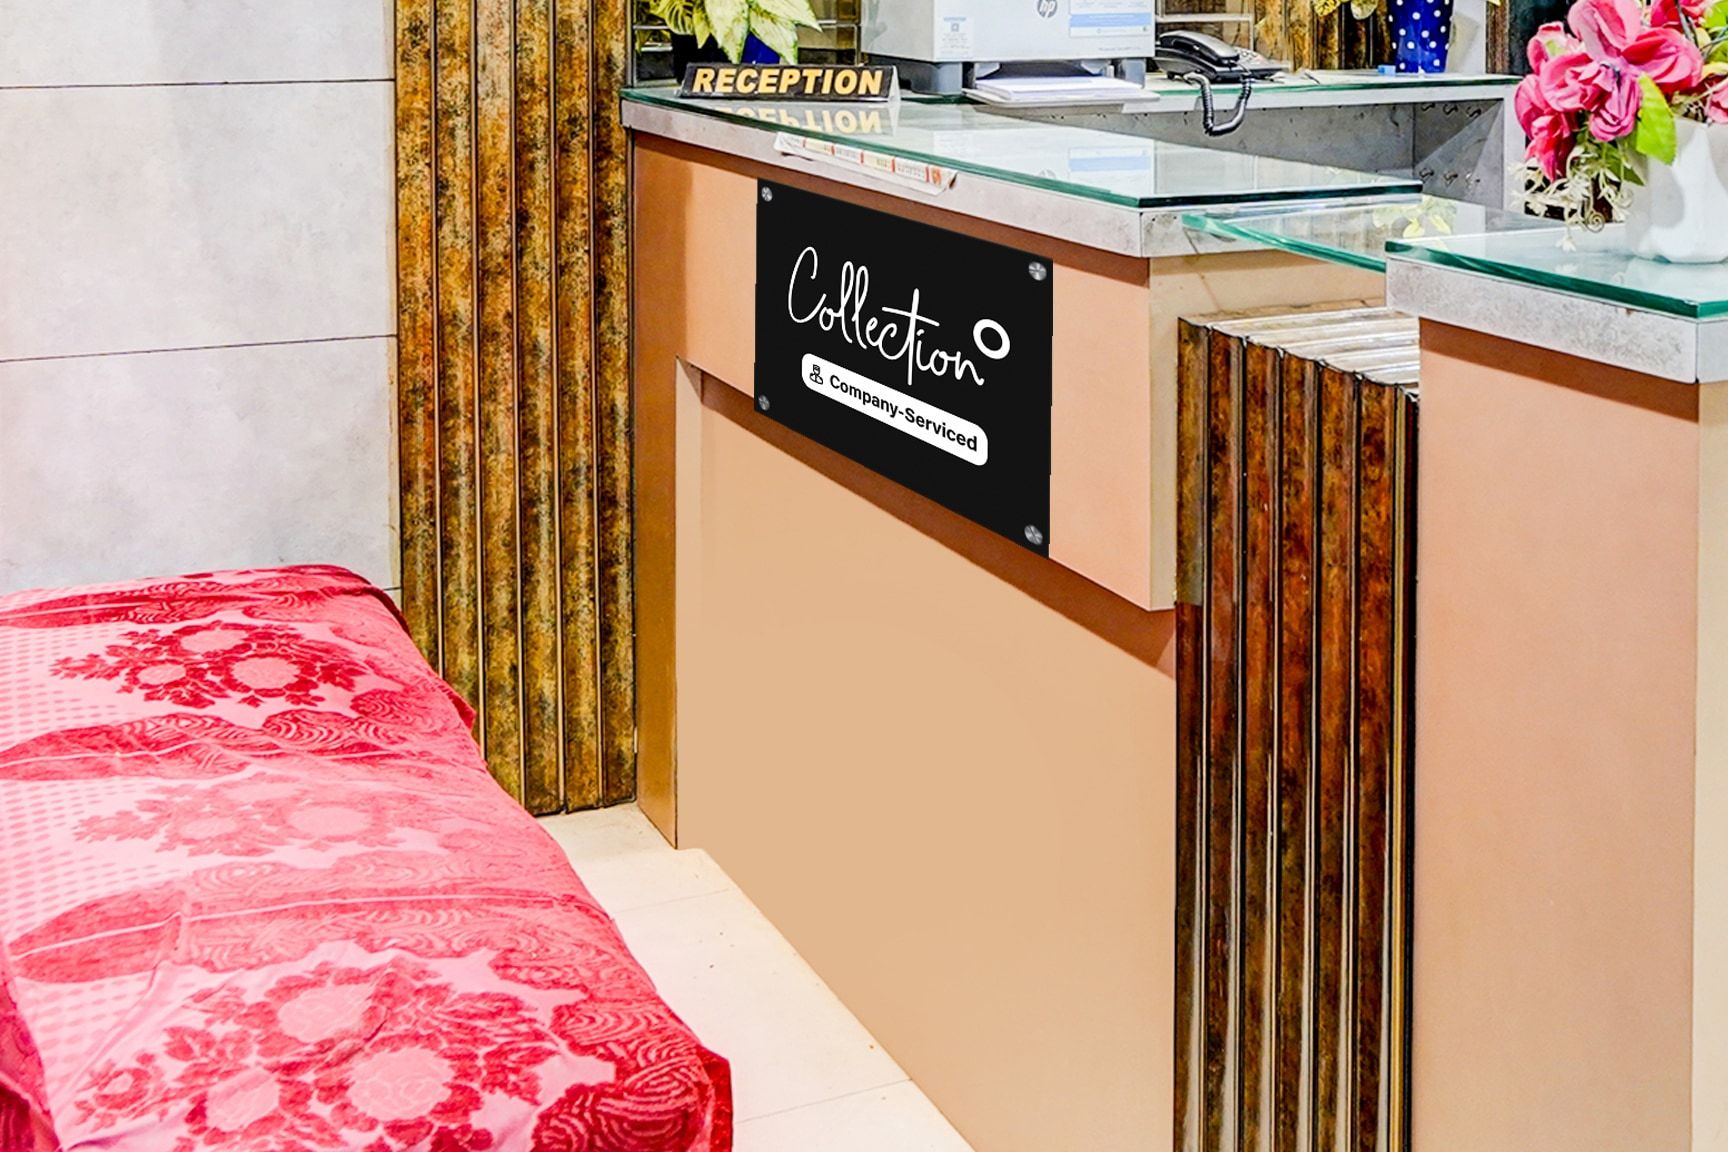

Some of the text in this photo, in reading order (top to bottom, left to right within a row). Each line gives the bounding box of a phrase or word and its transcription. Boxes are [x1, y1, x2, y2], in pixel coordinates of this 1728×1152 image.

[692, 67, 883, 95] RECEPTION
[788, 246, 985, 386] Collection
[829, 373, 978, 452] Company-Serviced
